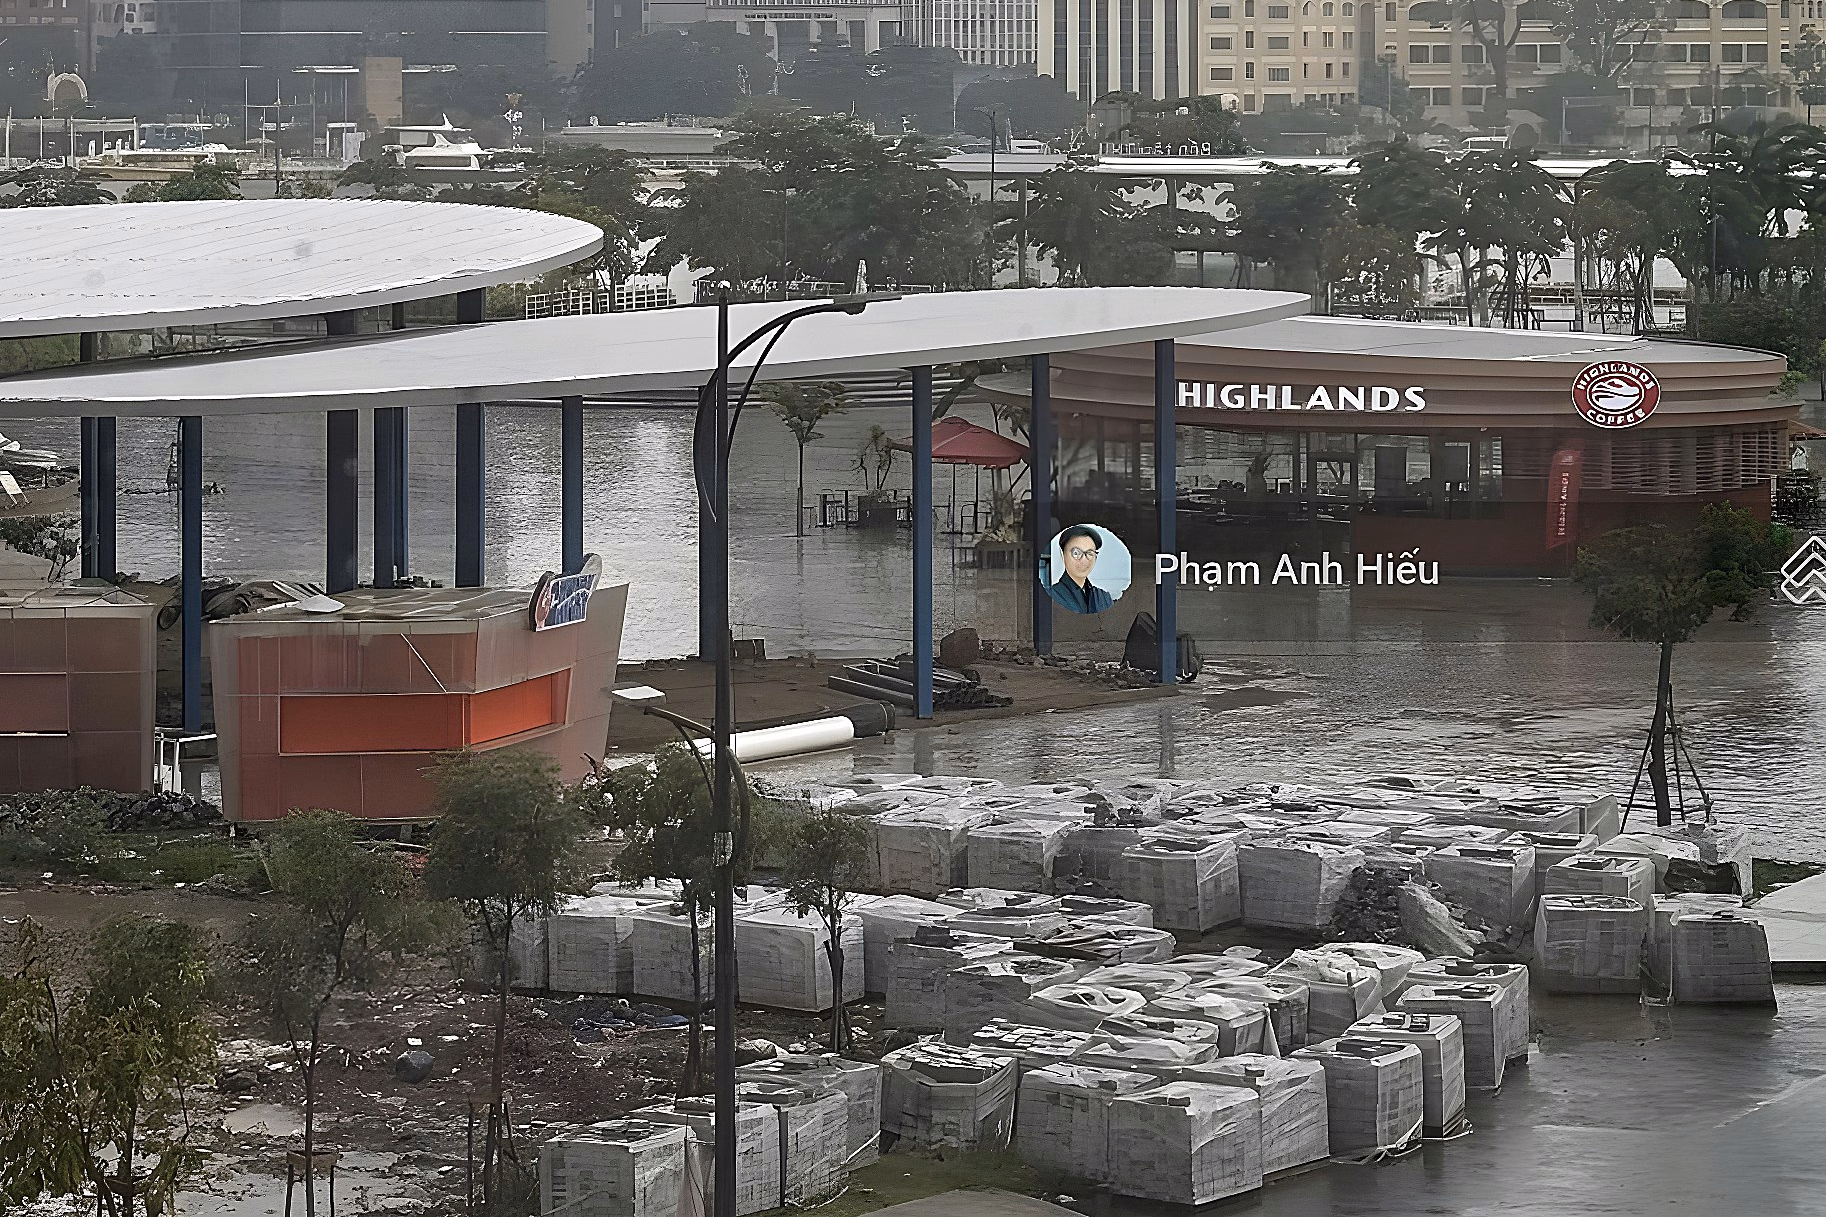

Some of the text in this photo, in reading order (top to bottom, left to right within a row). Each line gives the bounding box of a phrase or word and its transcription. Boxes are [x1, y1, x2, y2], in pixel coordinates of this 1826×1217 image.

[1576, 363, 1656, 390] HIGHLANDS
[1178, 382, 1426, 411] HIGHLANDS
[1586, 408, 1646, 424] COFFEE
